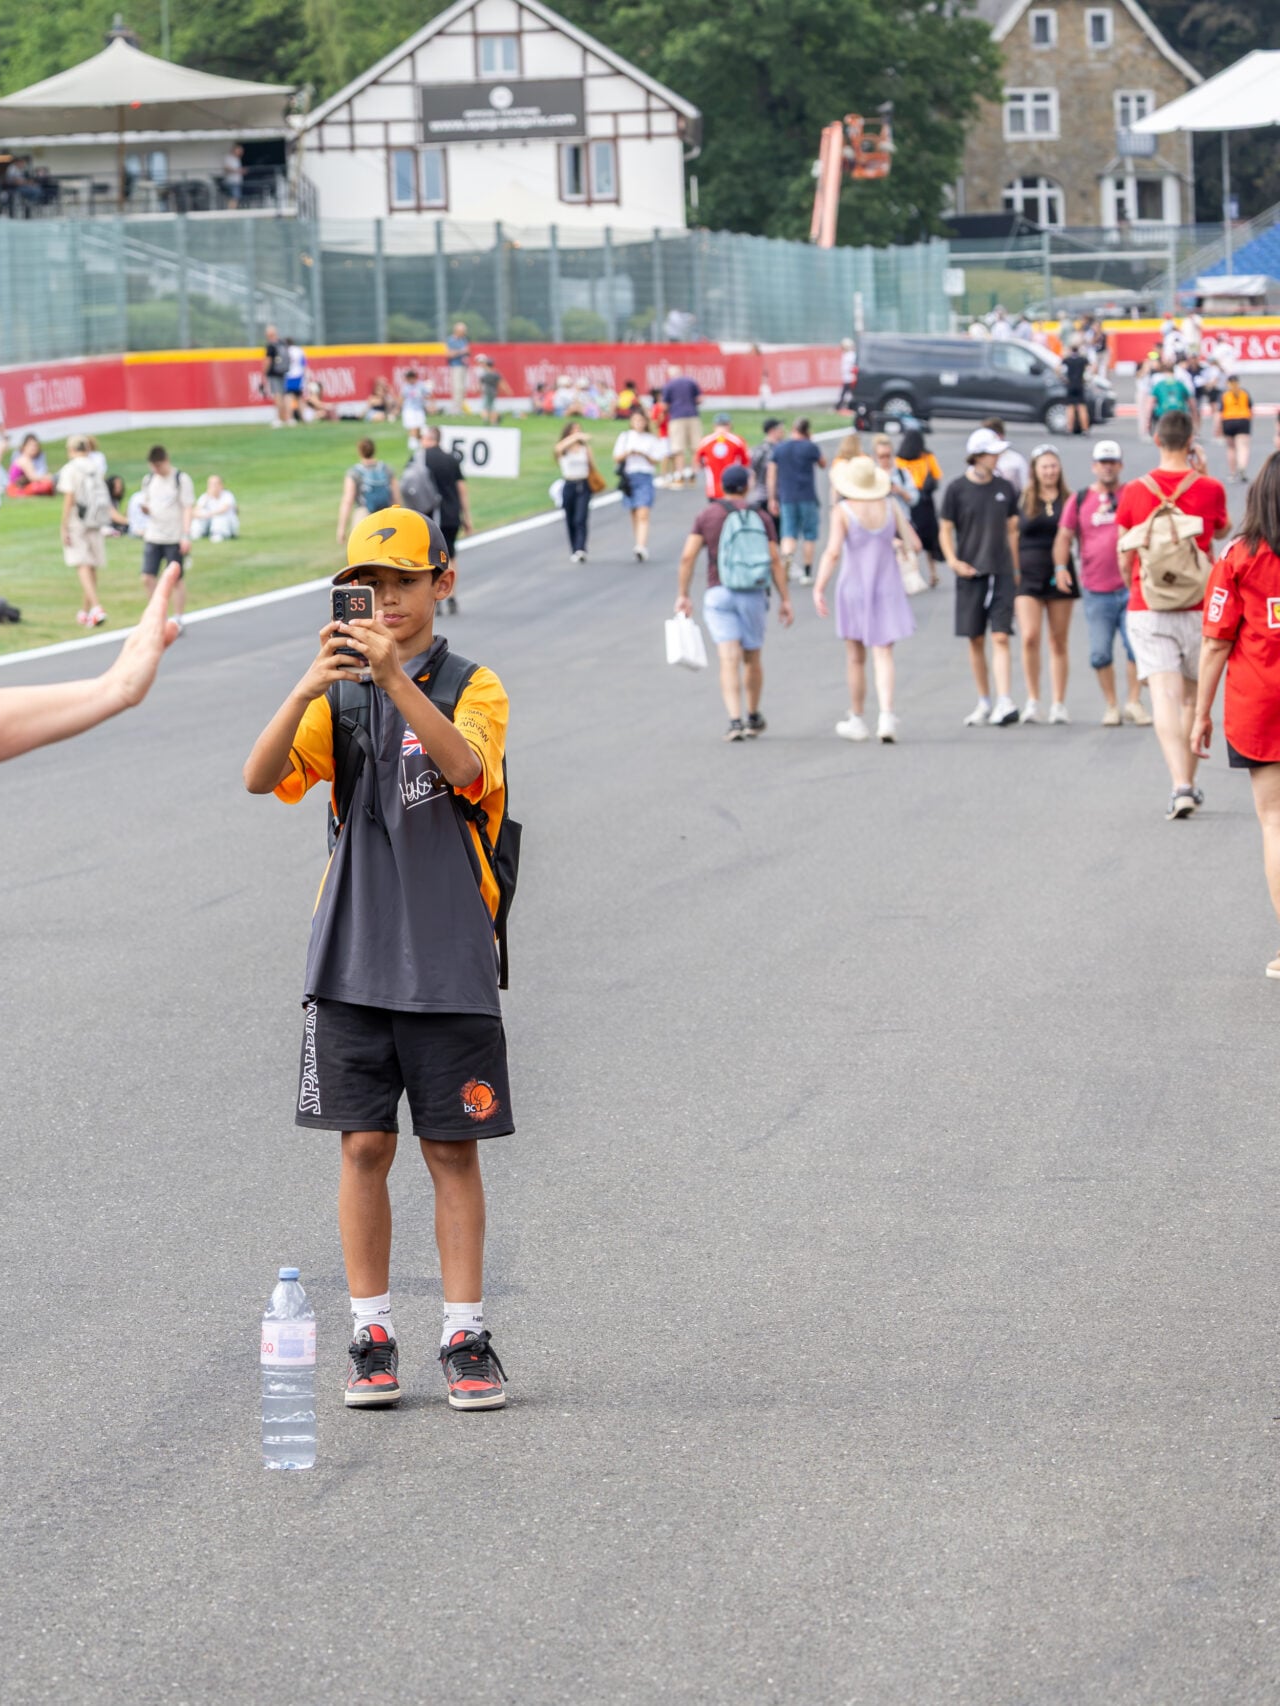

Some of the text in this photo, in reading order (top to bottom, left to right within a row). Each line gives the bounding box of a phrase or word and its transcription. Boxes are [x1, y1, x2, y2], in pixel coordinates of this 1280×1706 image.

[453, 440, 488, 466] 50
[350, 597, 366, 611] 55
[299, 1001, 321, 1114] SPALDIN
